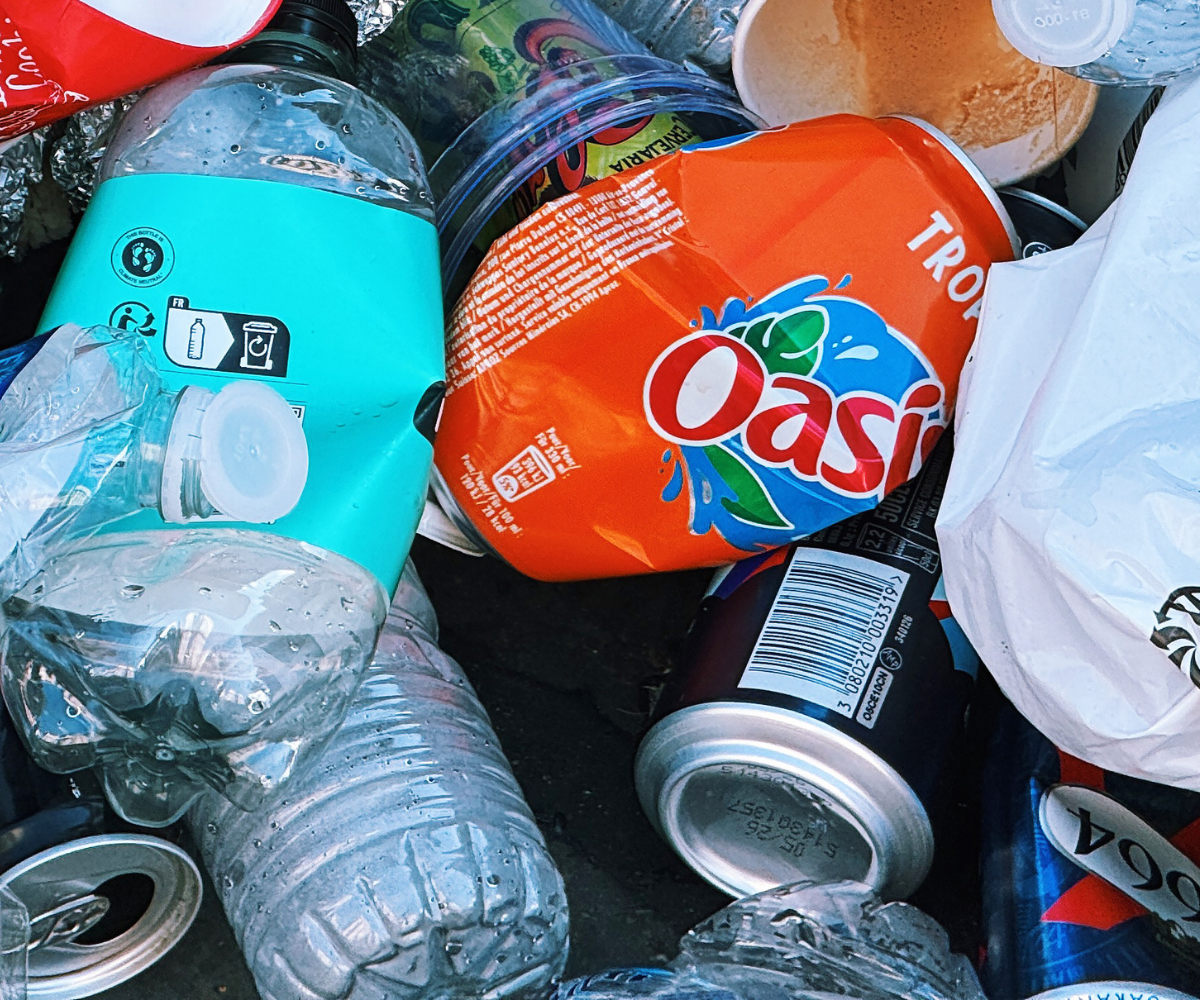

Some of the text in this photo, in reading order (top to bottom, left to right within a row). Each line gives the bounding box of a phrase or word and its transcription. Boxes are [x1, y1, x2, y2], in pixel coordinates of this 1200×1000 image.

[172, 297, 184, 307] FR
[542, 444, 561, 465] 330
[893, 612, 914, 645] 340126
[836, 583, 901, 713] 3 080210 003319
